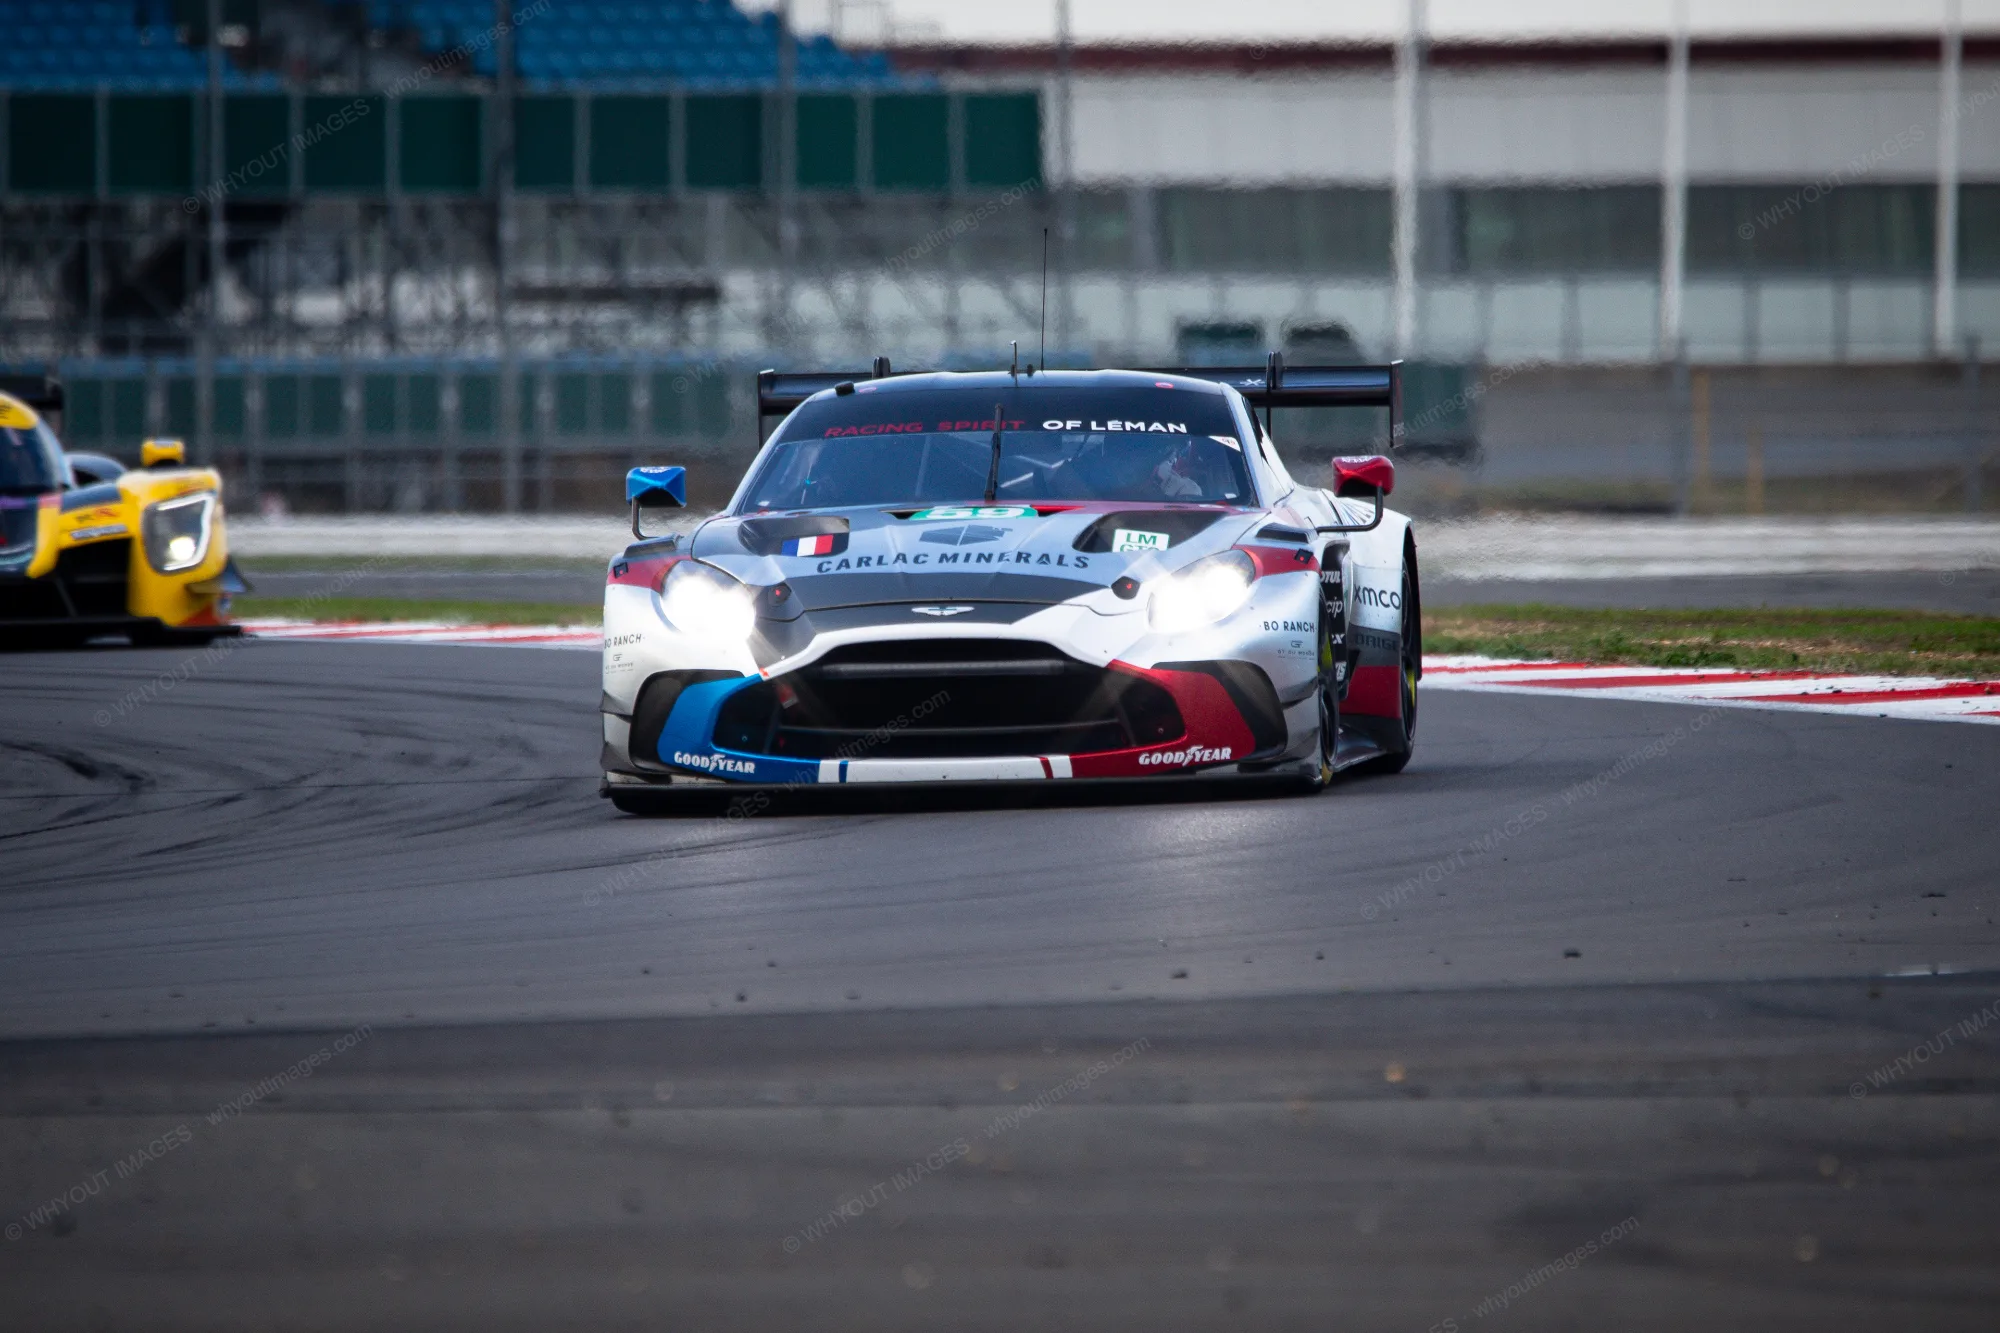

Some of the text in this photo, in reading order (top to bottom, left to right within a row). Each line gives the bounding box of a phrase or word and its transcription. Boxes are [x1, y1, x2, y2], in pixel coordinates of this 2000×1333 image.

[824, 421, 923, 438] RACING
[1042, 420, 1082, 430] OF
[1125, 532, 1158, 545] LM
[816, 550, 1090, 573] CARLAC MINERALS
[1263, 620, 1315, 633] BO RANCH
[613, 633, 642, 647] RANCH
[674, 750, 755, 774] GOODYEAR
[1138, 745, 1232, 767] GOODYEAR
